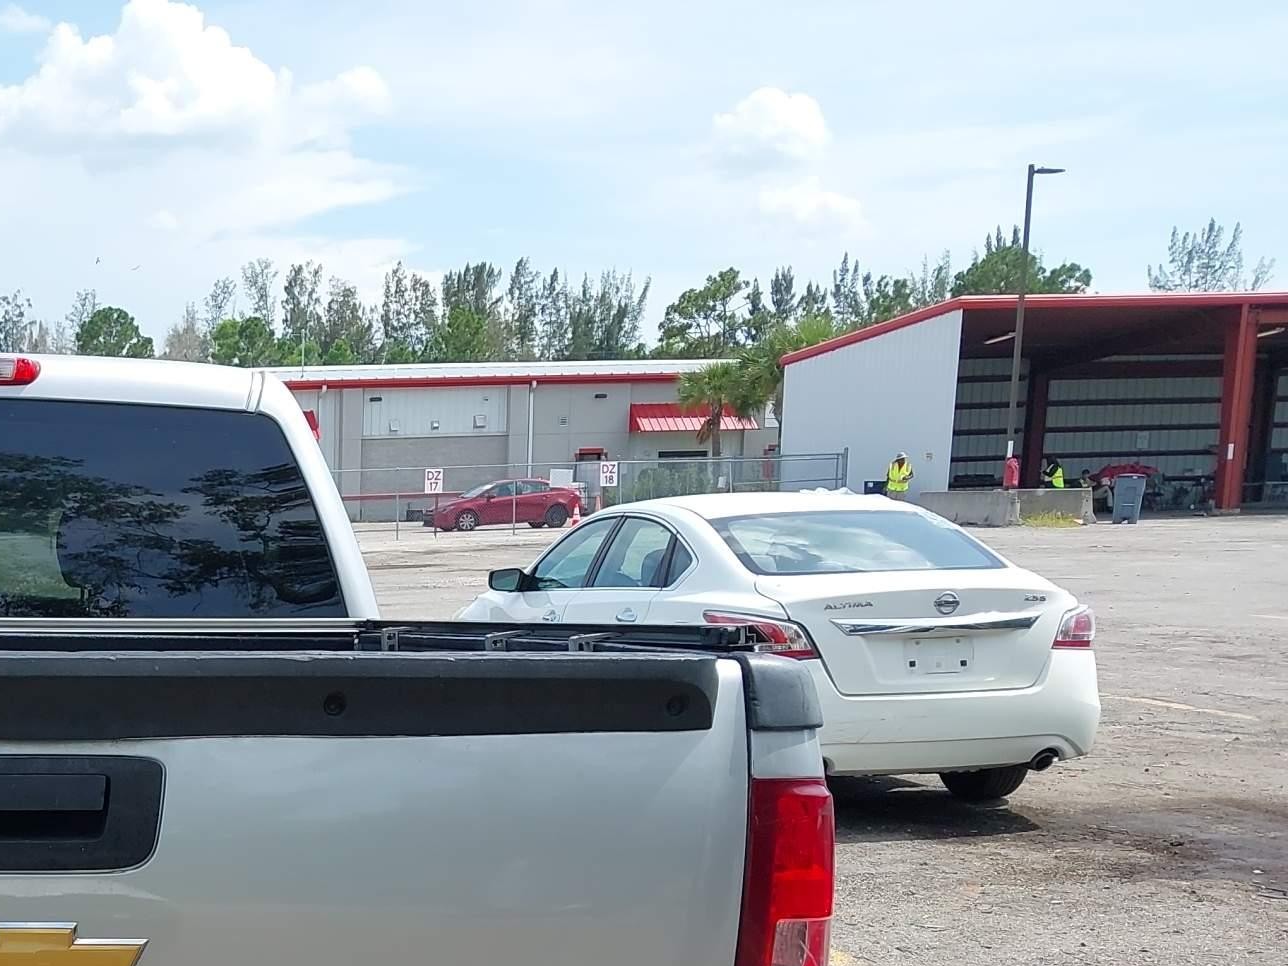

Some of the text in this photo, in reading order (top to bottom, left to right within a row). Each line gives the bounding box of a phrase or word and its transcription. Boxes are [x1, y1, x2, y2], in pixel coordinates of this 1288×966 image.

[602, 464, 616, 474] DZ
[427, 470, 441, 480] DZ
[605, 475, 614, 484] 18
[429, 481, 438, 491] 17
